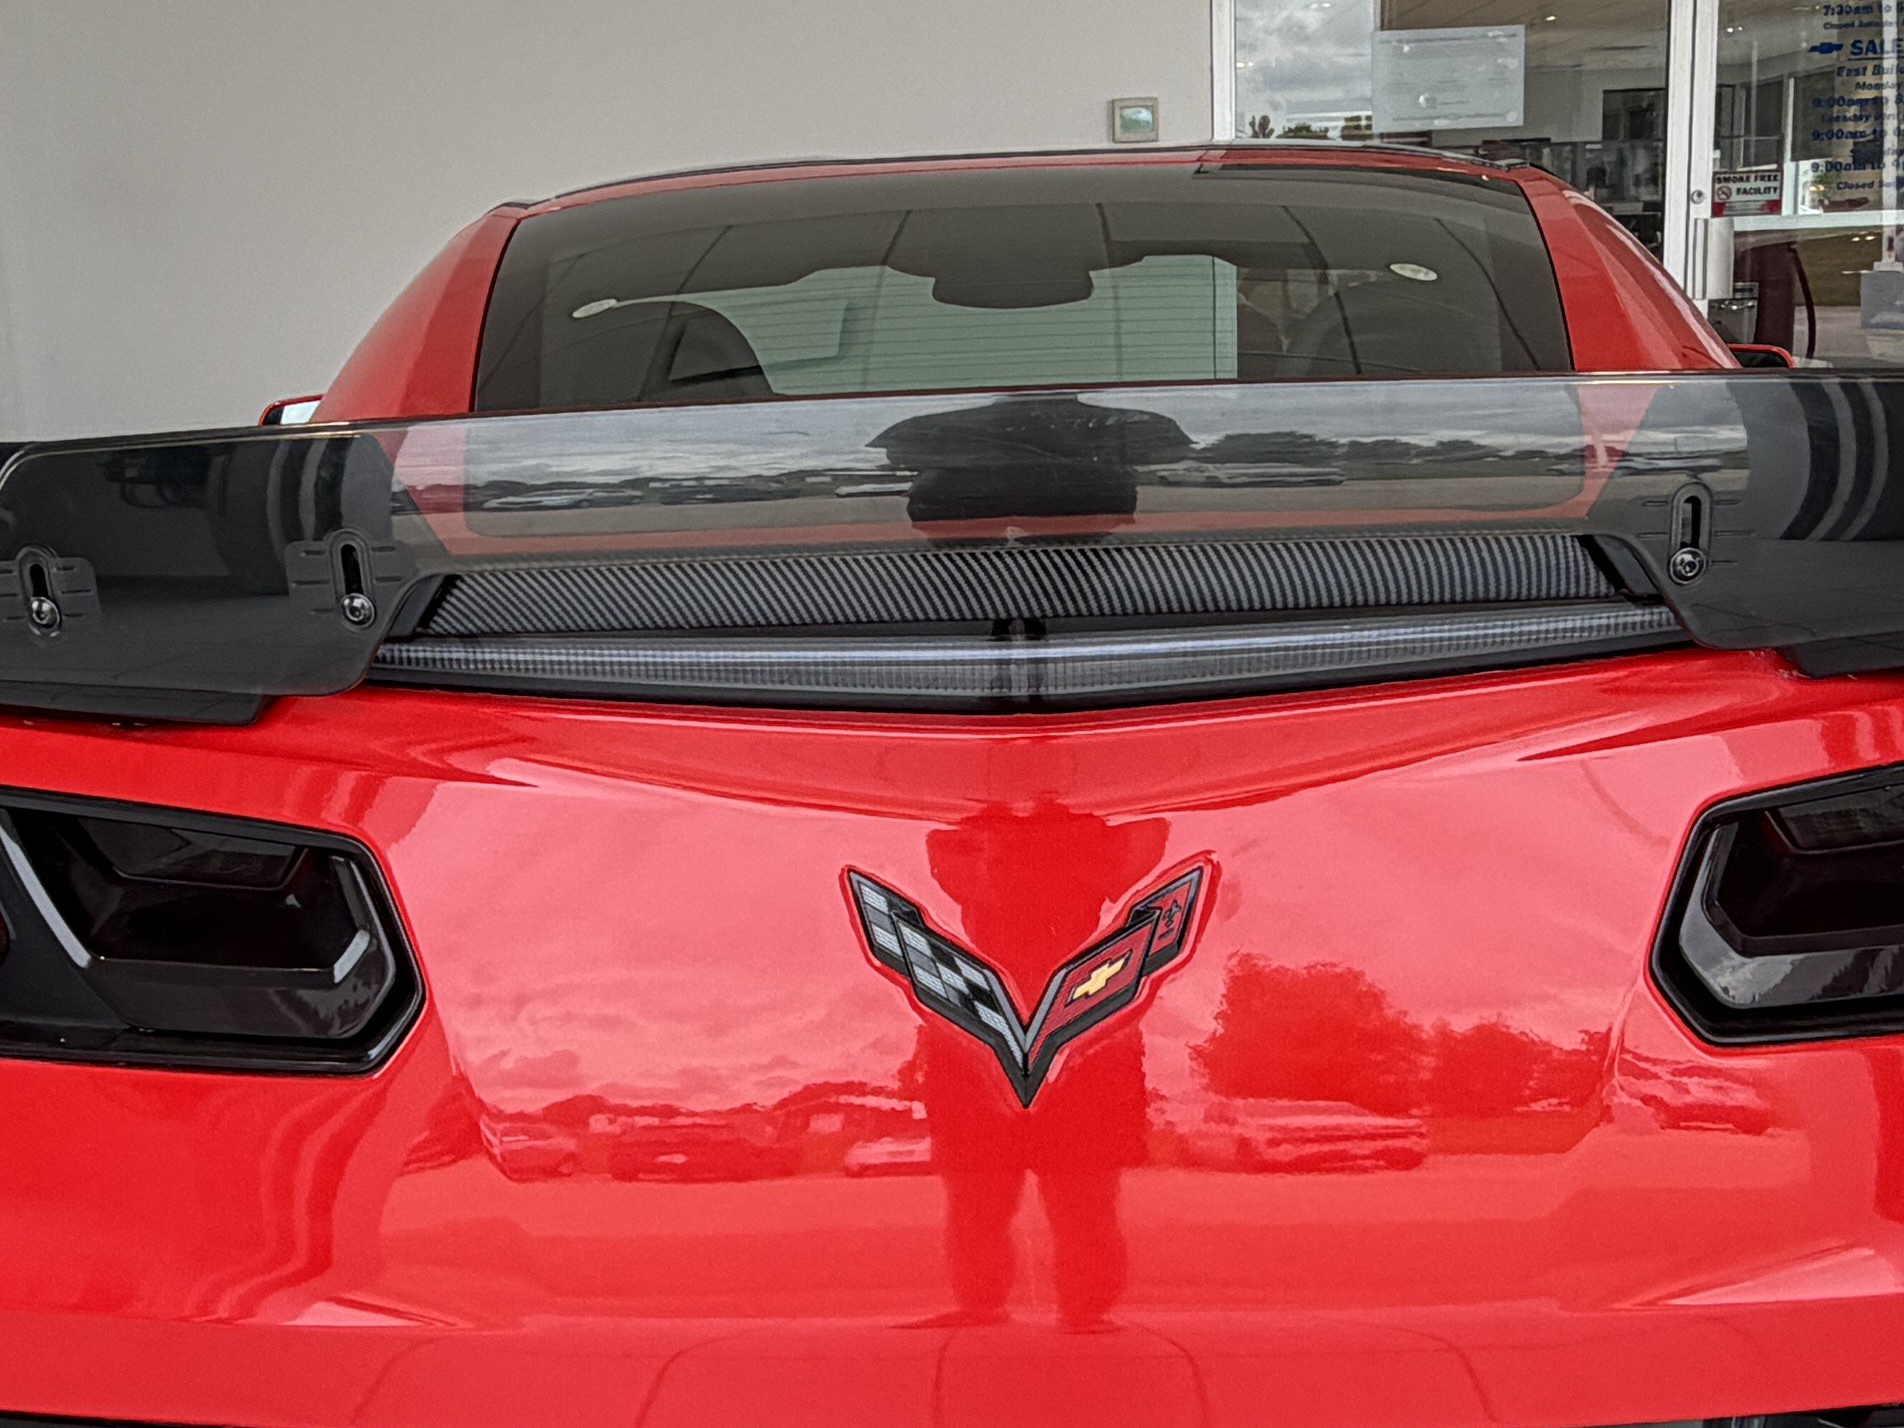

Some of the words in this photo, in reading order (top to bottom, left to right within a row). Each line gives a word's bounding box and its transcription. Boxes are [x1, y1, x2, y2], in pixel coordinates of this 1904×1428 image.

[1716, 175, 1751, 184] SMOKE
[1754, 174, 1779, 182] FREE
[1736, 186, 1778, 195] FACILITY
